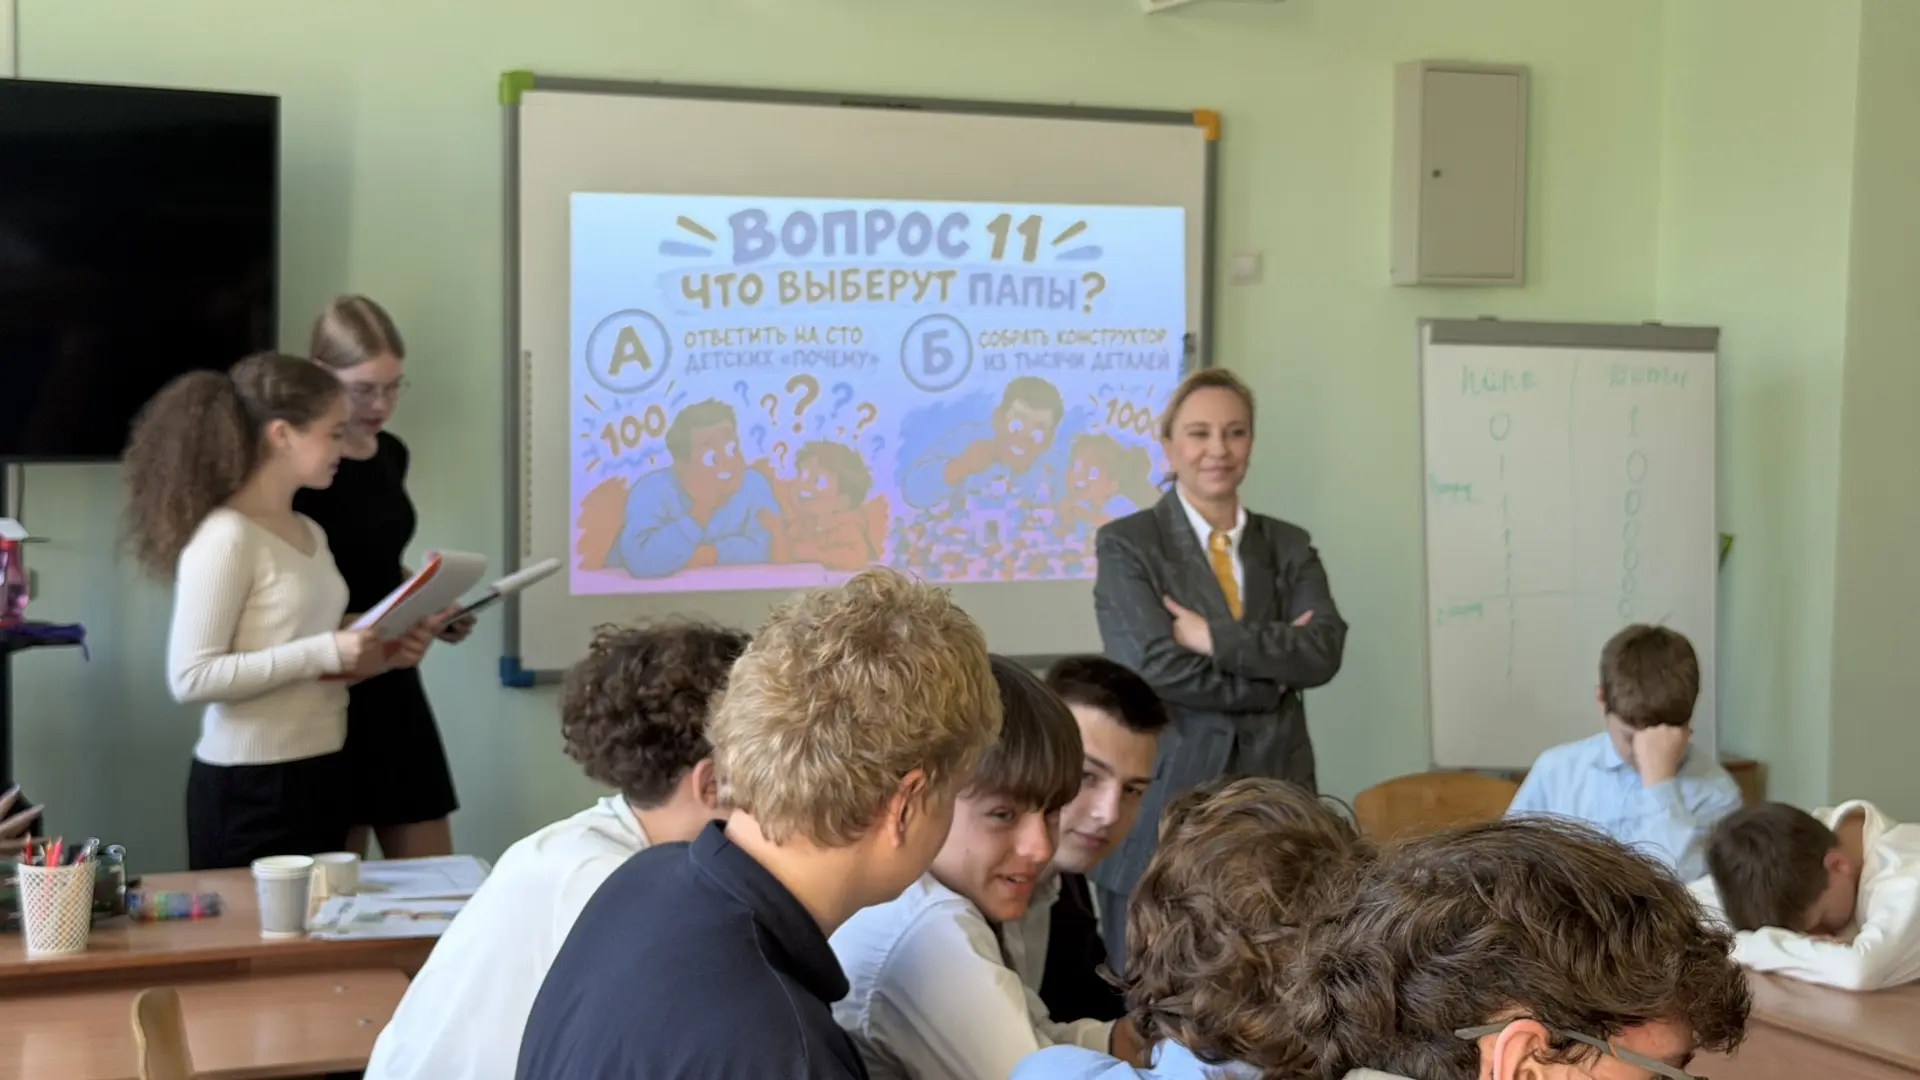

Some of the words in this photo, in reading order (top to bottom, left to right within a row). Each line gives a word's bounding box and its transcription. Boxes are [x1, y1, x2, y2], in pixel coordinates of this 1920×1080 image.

[729, 208, 970, 265] ВОПРОС
[986, 214, 1042, 262] 11
[681, 271, 764, 309] ЧТО
[778, 268, 957, 304] ВЫБЕРУТ
[968, 272, 1107, 314] ПАПЫ?
[608, 326, 653, 374] А
[683, 328, 788, 349] ОТВЕТИТЬ
[795, 326, 820, 345] НА
[826, 325, 864, 345] СТО
[921, 329, 954, 376] Б
[978, 328, 1049, 349] СОБРАТЬ
[1056, 328, 1168, 347] КОНСТРУКТОР
[984, 353, 1007, 371] ИЗ
[1014, 353, 1085, 371] ТЫСЯЧИ
[1091, 349, 1170, 371] ДЕТАЛЕЙ
[684, 350, 775, 376] ДЕТСКИХ
[780, 349, 881, 370] «ПОЧЕМУ»
[599, 403, 668, 457] 100
